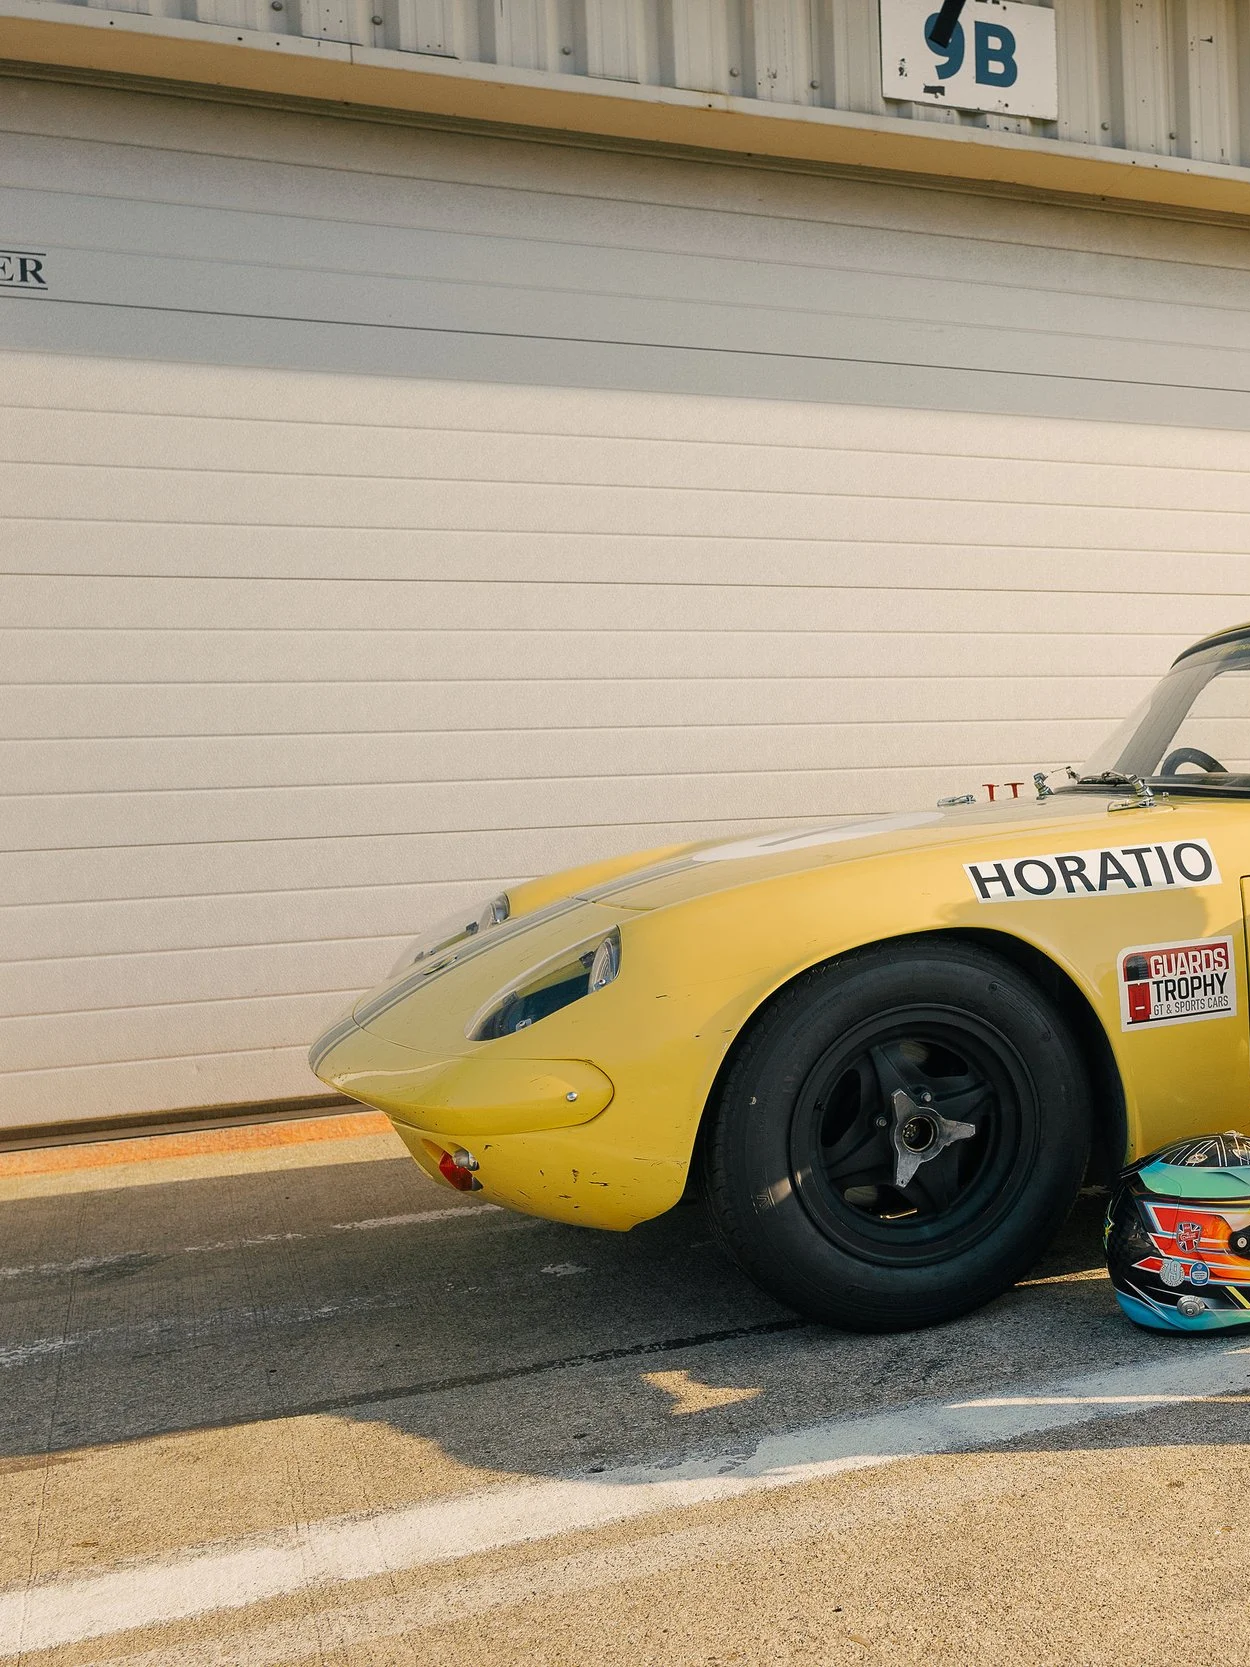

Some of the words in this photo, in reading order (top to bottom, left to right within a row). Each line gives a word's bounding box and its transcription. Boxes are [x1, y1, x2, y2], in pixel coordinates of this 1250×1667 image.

[924, 12, 1018, 88] 9B
[968, 842, 1213, 899] HORATIO
[1149, 947, 1227, 979] GUARDS
[1152, 971, 1228, 1003] TROPHY
[1153, 1003, 1164, 1016] GT
[1166, 1004, 1173, 1015] &
[1174, 999, 1206, 1014] SPORTS
[1207, 995, 1229, 1008] CARS
